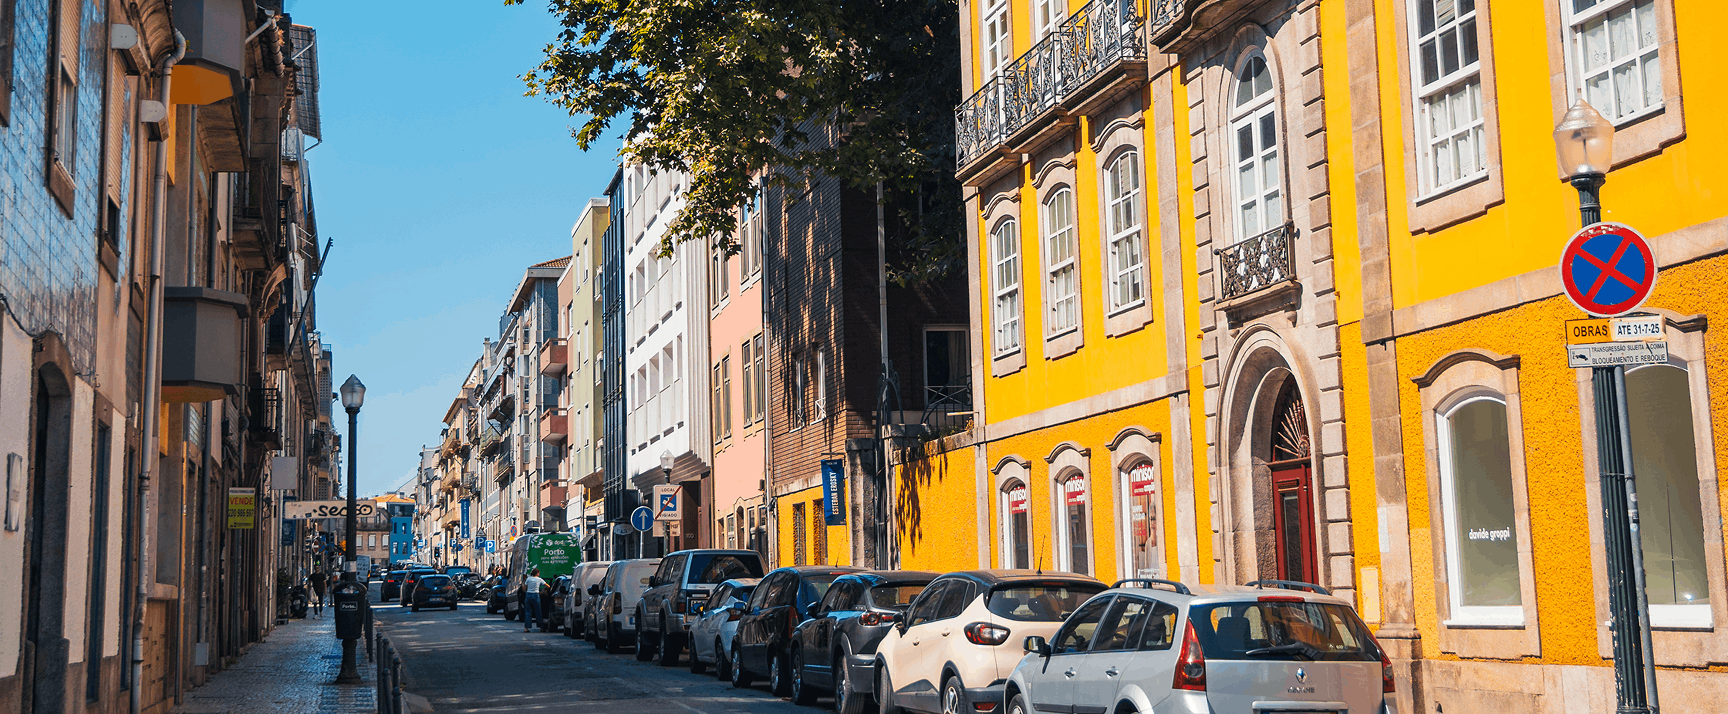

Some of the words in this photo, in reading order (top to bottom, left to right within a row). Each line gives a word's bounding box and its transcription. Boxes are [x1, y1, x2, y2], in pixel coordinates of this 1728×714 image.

[1573, 325, 1608, 337] OBRAS
[1617, 322, 1632, 335] ATÉ
[1633, 323, 1660, 335] 31-7-25
[1591, 344, 1626, 353] TRANSGRESSÃO
[1592, 355, 1634, 364] BLOQUEAMENTO
[1640, 353, 1666, 362] REBOQUE
[229, 496, 254, 505] VENDE
[1468, 527, 1489, 540] davide
[1490, 526, 1510, 541] groppi
[478, 538, 484, 547] P
[487, 542, 493, 551] P
